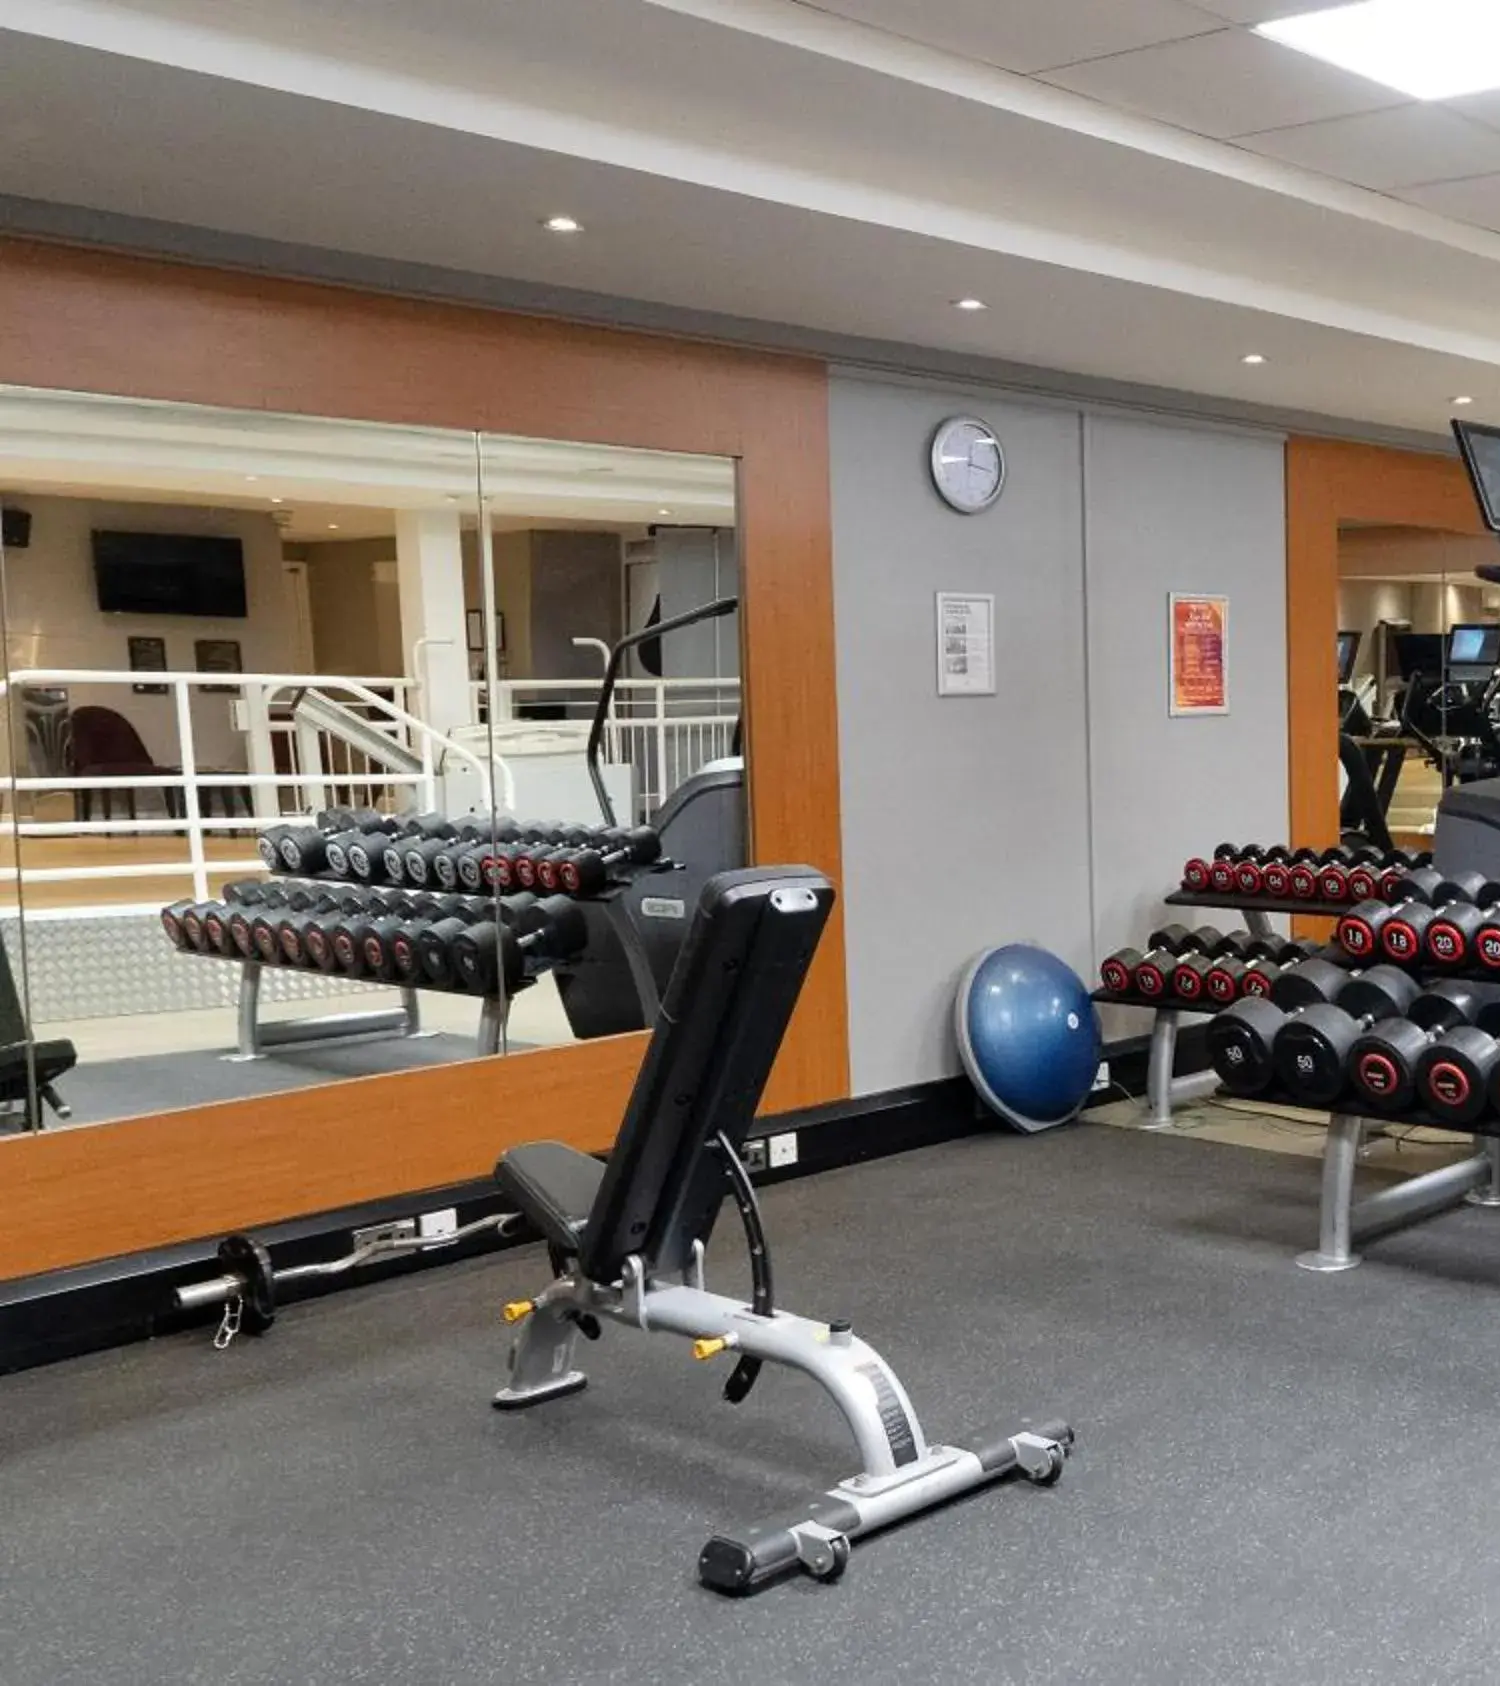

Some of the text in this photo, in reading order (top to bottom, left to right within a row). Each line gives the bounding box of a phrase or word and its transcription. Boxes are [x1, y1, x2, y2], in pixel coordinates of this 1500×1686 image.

[1348, 928, 1363, 945] 18
[1392, 933, 1407, 948] 18
[1436, 935, 1453, 949] 20
[1226, 1045, 1243, 1061] 50
[1296, 1055, 1313, 1069] 50
